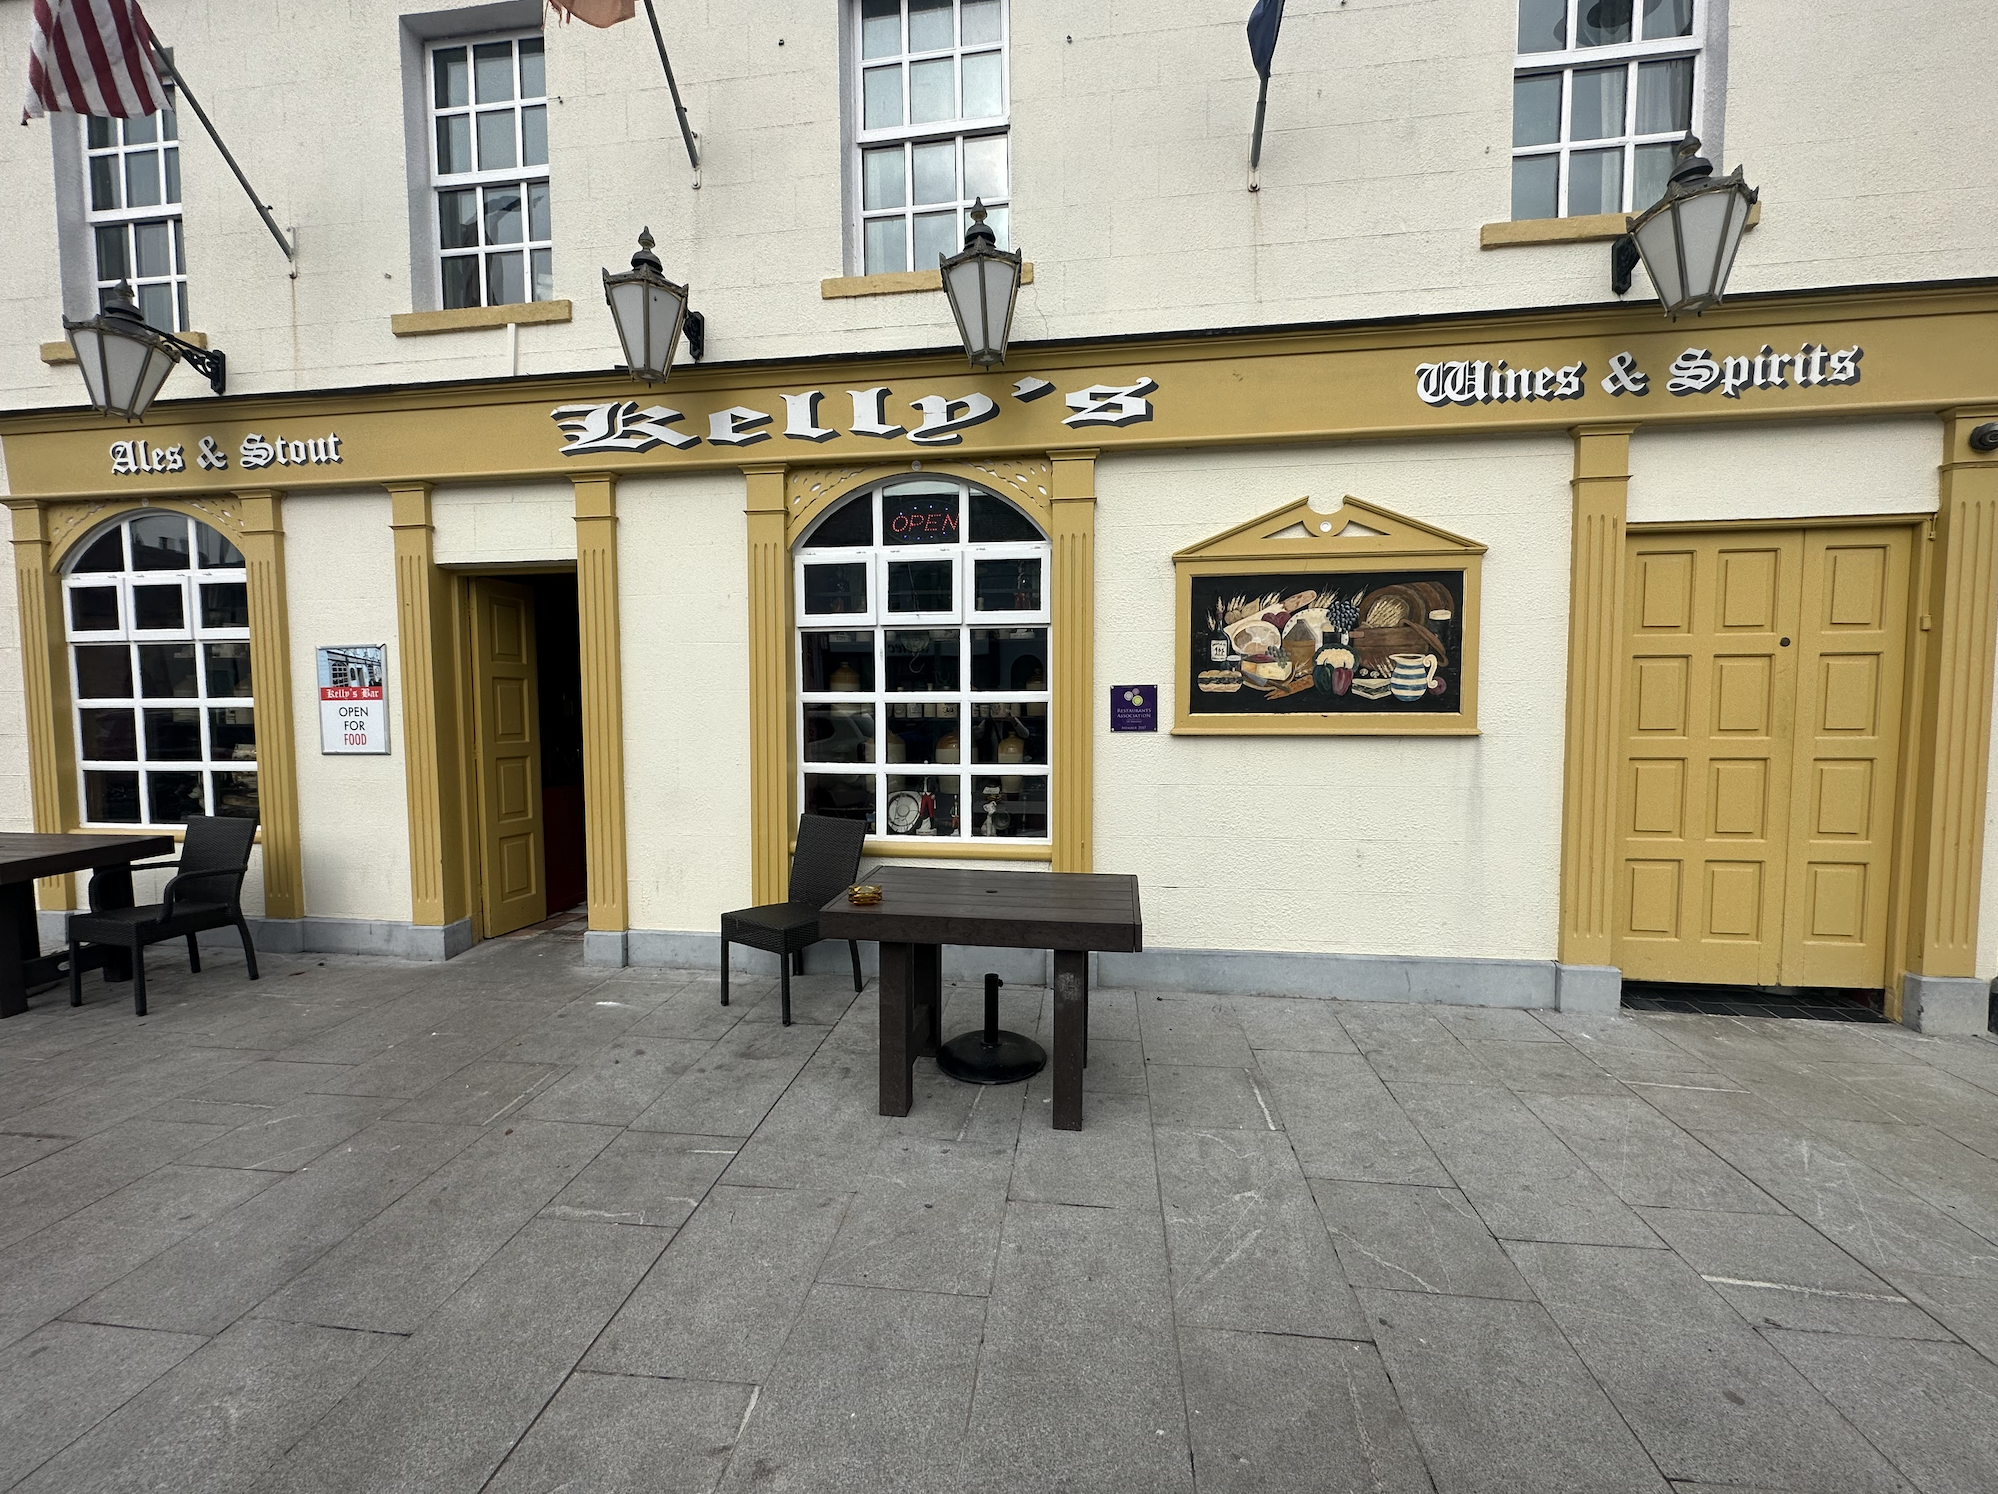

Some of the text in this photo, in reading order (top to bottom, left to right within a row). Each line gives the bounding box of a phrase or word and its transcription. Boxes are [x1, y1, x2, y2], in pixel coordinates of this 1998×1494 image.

[1415, 342, 1864, 407] Wines & Spirits
[550, 376, 1159, 456] Kelly's
[109, 432, 343, 476] Ales & Stout
[891, 513, 959, 533] OPEN
[326, 688, 379, 699] Kelly's Bar
[339, 706, 369, 717] OPEN
[344, 720, 365, 731] FOR
[344, 733, 367, 746] FOOD
